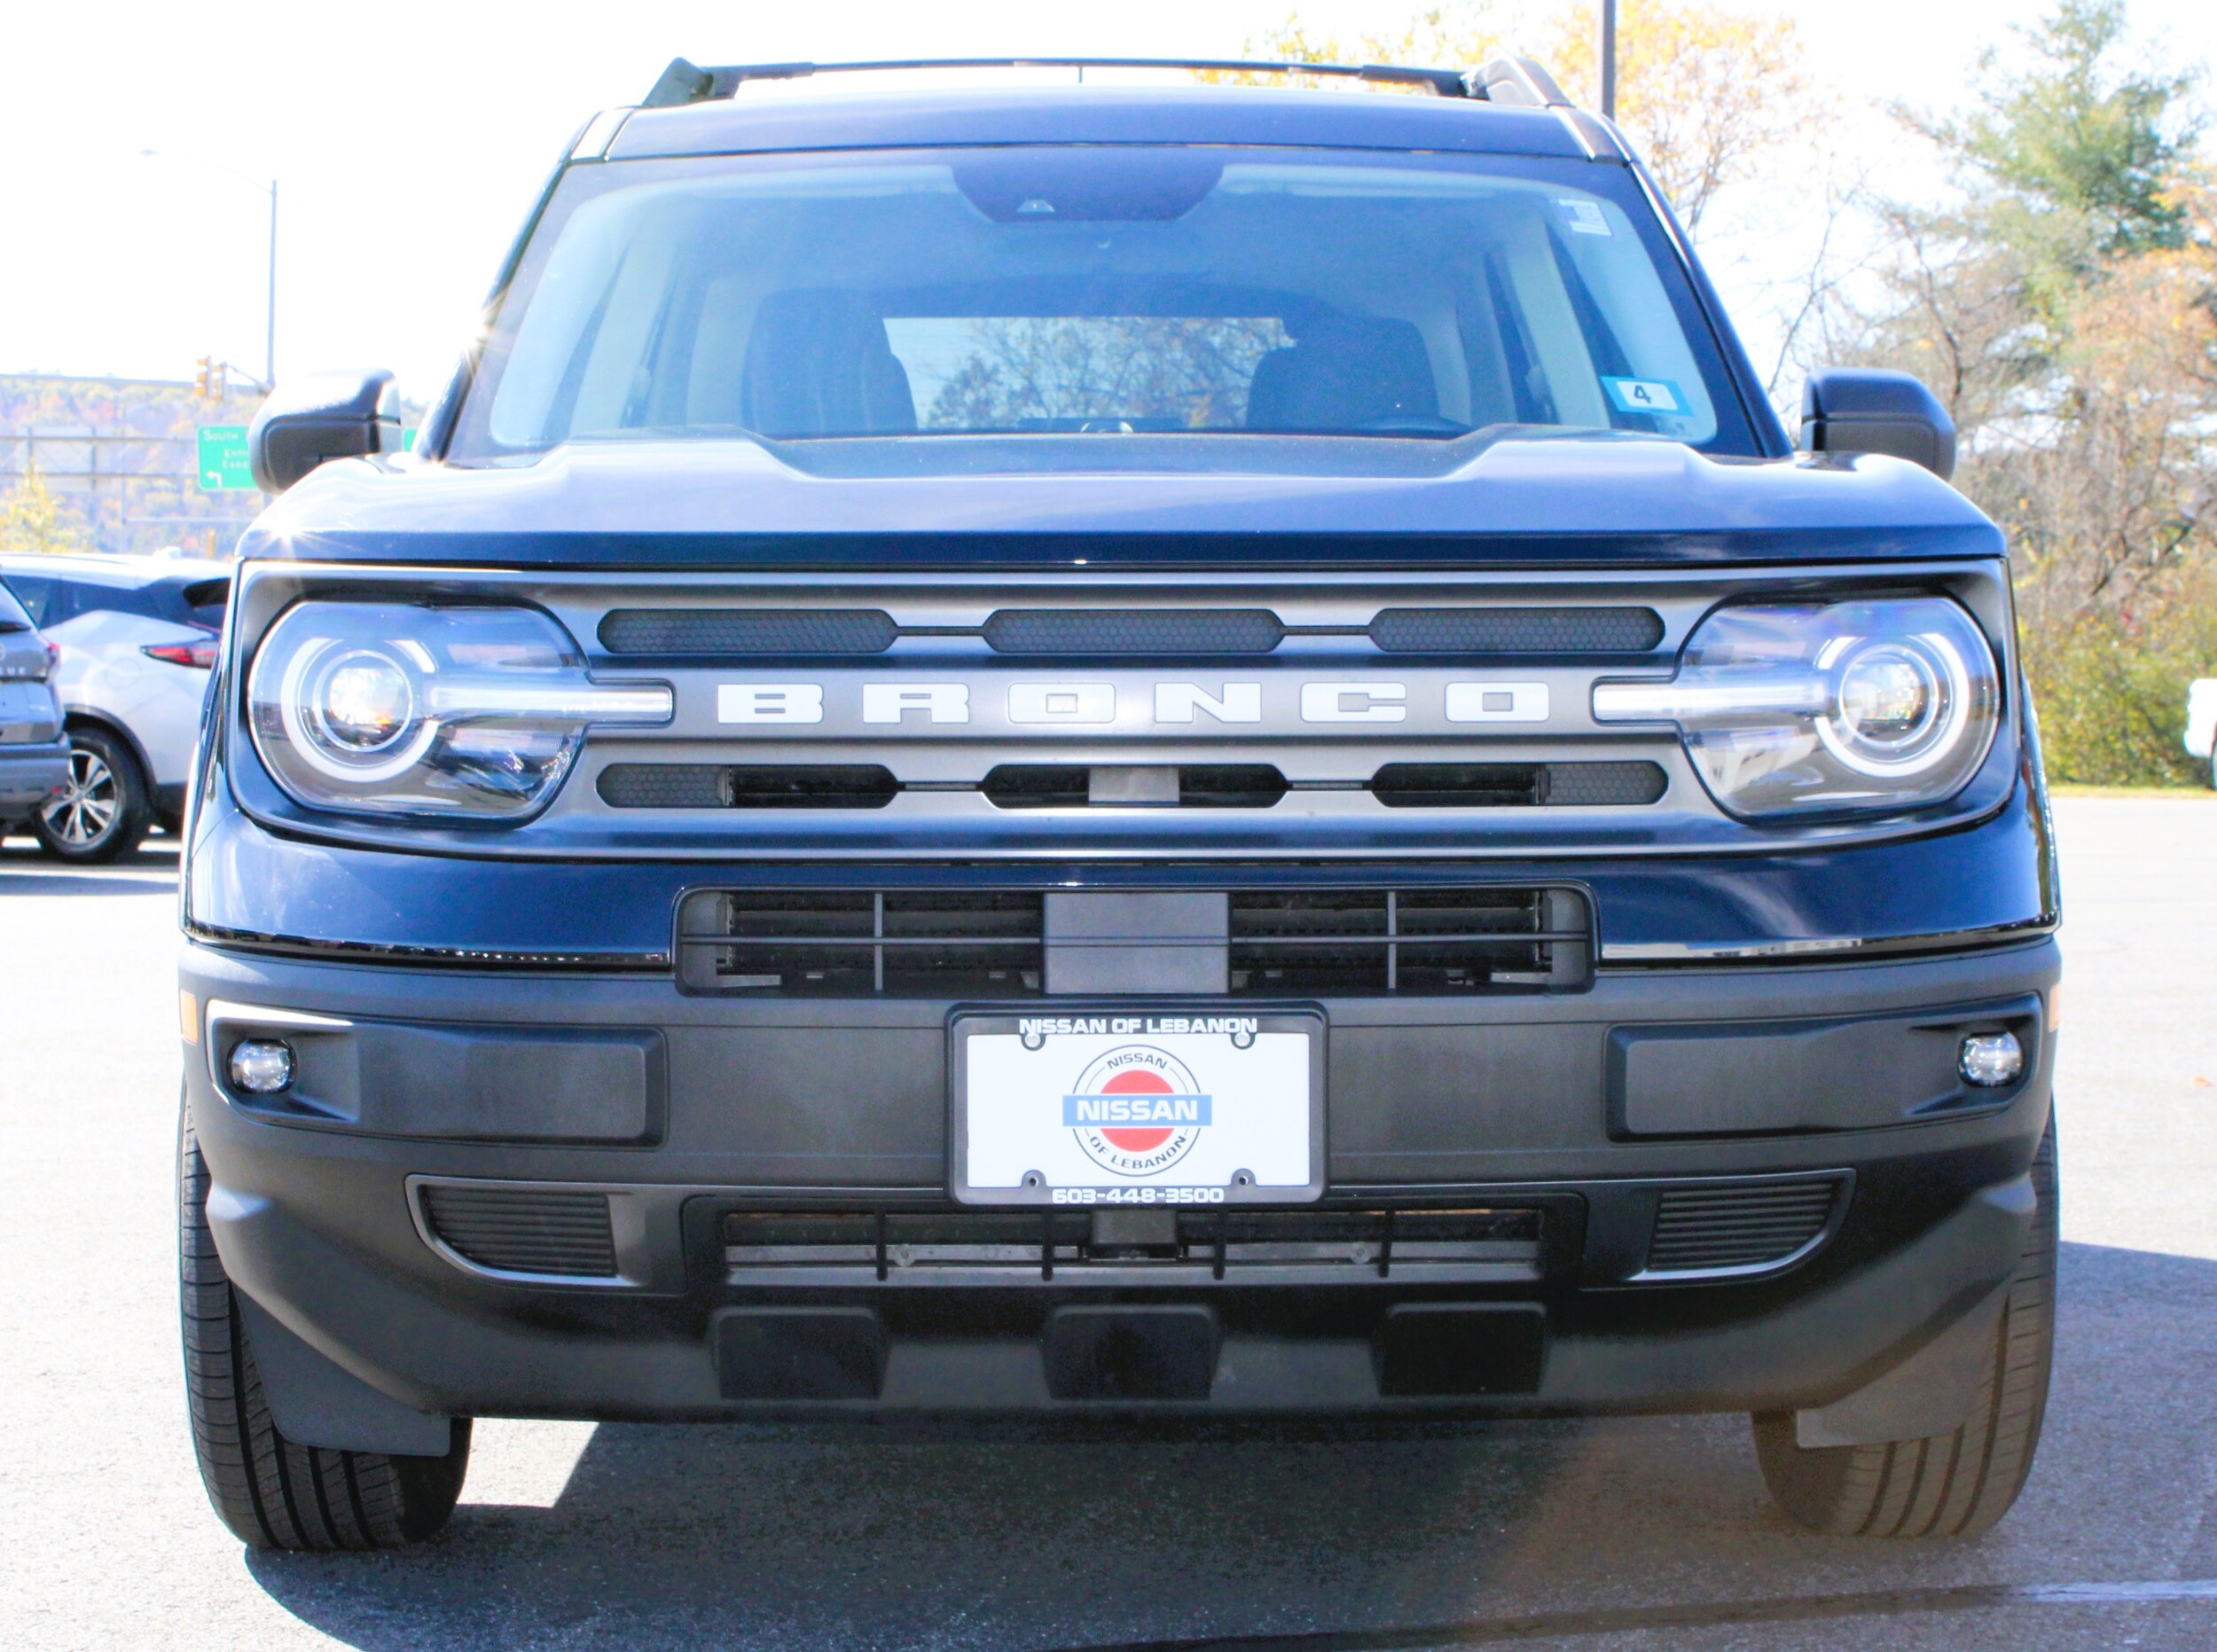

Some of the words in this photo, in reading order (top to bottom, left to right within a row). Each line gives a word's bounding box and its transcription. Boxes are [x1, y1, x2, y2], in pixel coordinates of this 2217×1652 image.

[1633, 385, 1651, 403] 4
[717, 682, 1550, 724] BRONCO
[1019, 1018, 1106, 1034] NISSAN
[1111, 1018, 1141, 1034] OF
[1147, 1018, 1257, 1033] LEBANON
[1107, 1053, 1168, 1069] NISSAN
[1076, 1099, 1198, 1122] NISSAN
[1089, 1135, 1109, 1155] OF
[1110, 1135, 1187, 1170] LEBANON
[1052, 1187, 1225, 1205] 603-448-3500
